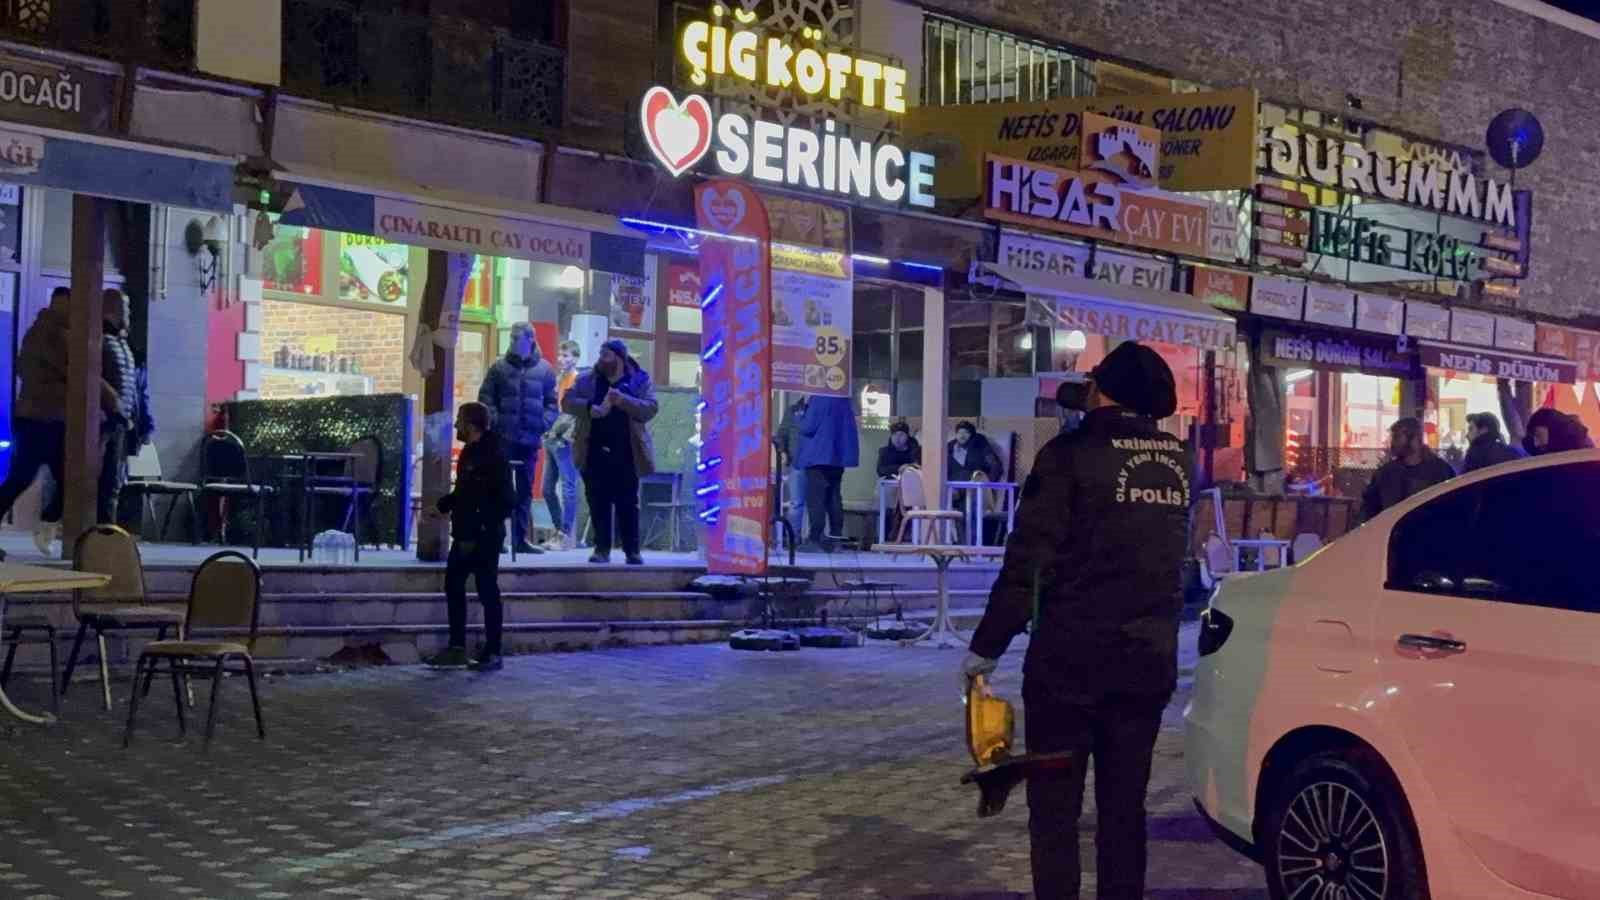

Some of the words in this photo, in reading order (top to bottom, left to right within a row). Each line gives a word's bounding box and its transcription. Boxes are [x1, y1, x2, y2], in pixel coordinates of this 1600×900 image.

[682, 4, 758, 86] ÇİĞ
[766, 26, 907, 114] KÖFTE
[0, 70, 81, 113] OCAĞI
[998, 107, 1060, 141] NEFİS
[1151, 104, 1236, 133] SALONU
[715, 112, 936, 209] SERİNCE
[992, 160, 1121, 232] HİSAR
[1124, 204, 1168, 241] ÇAY
[1006, 243, 1077, 275] HİSAR
[815, 336, 839, 354] 85
[1440, 352, 1492, 374] NEFİS
[1499, 360, 1560, 382] DÜRÜM
[1130, 486, 1182, 505] POLİS
